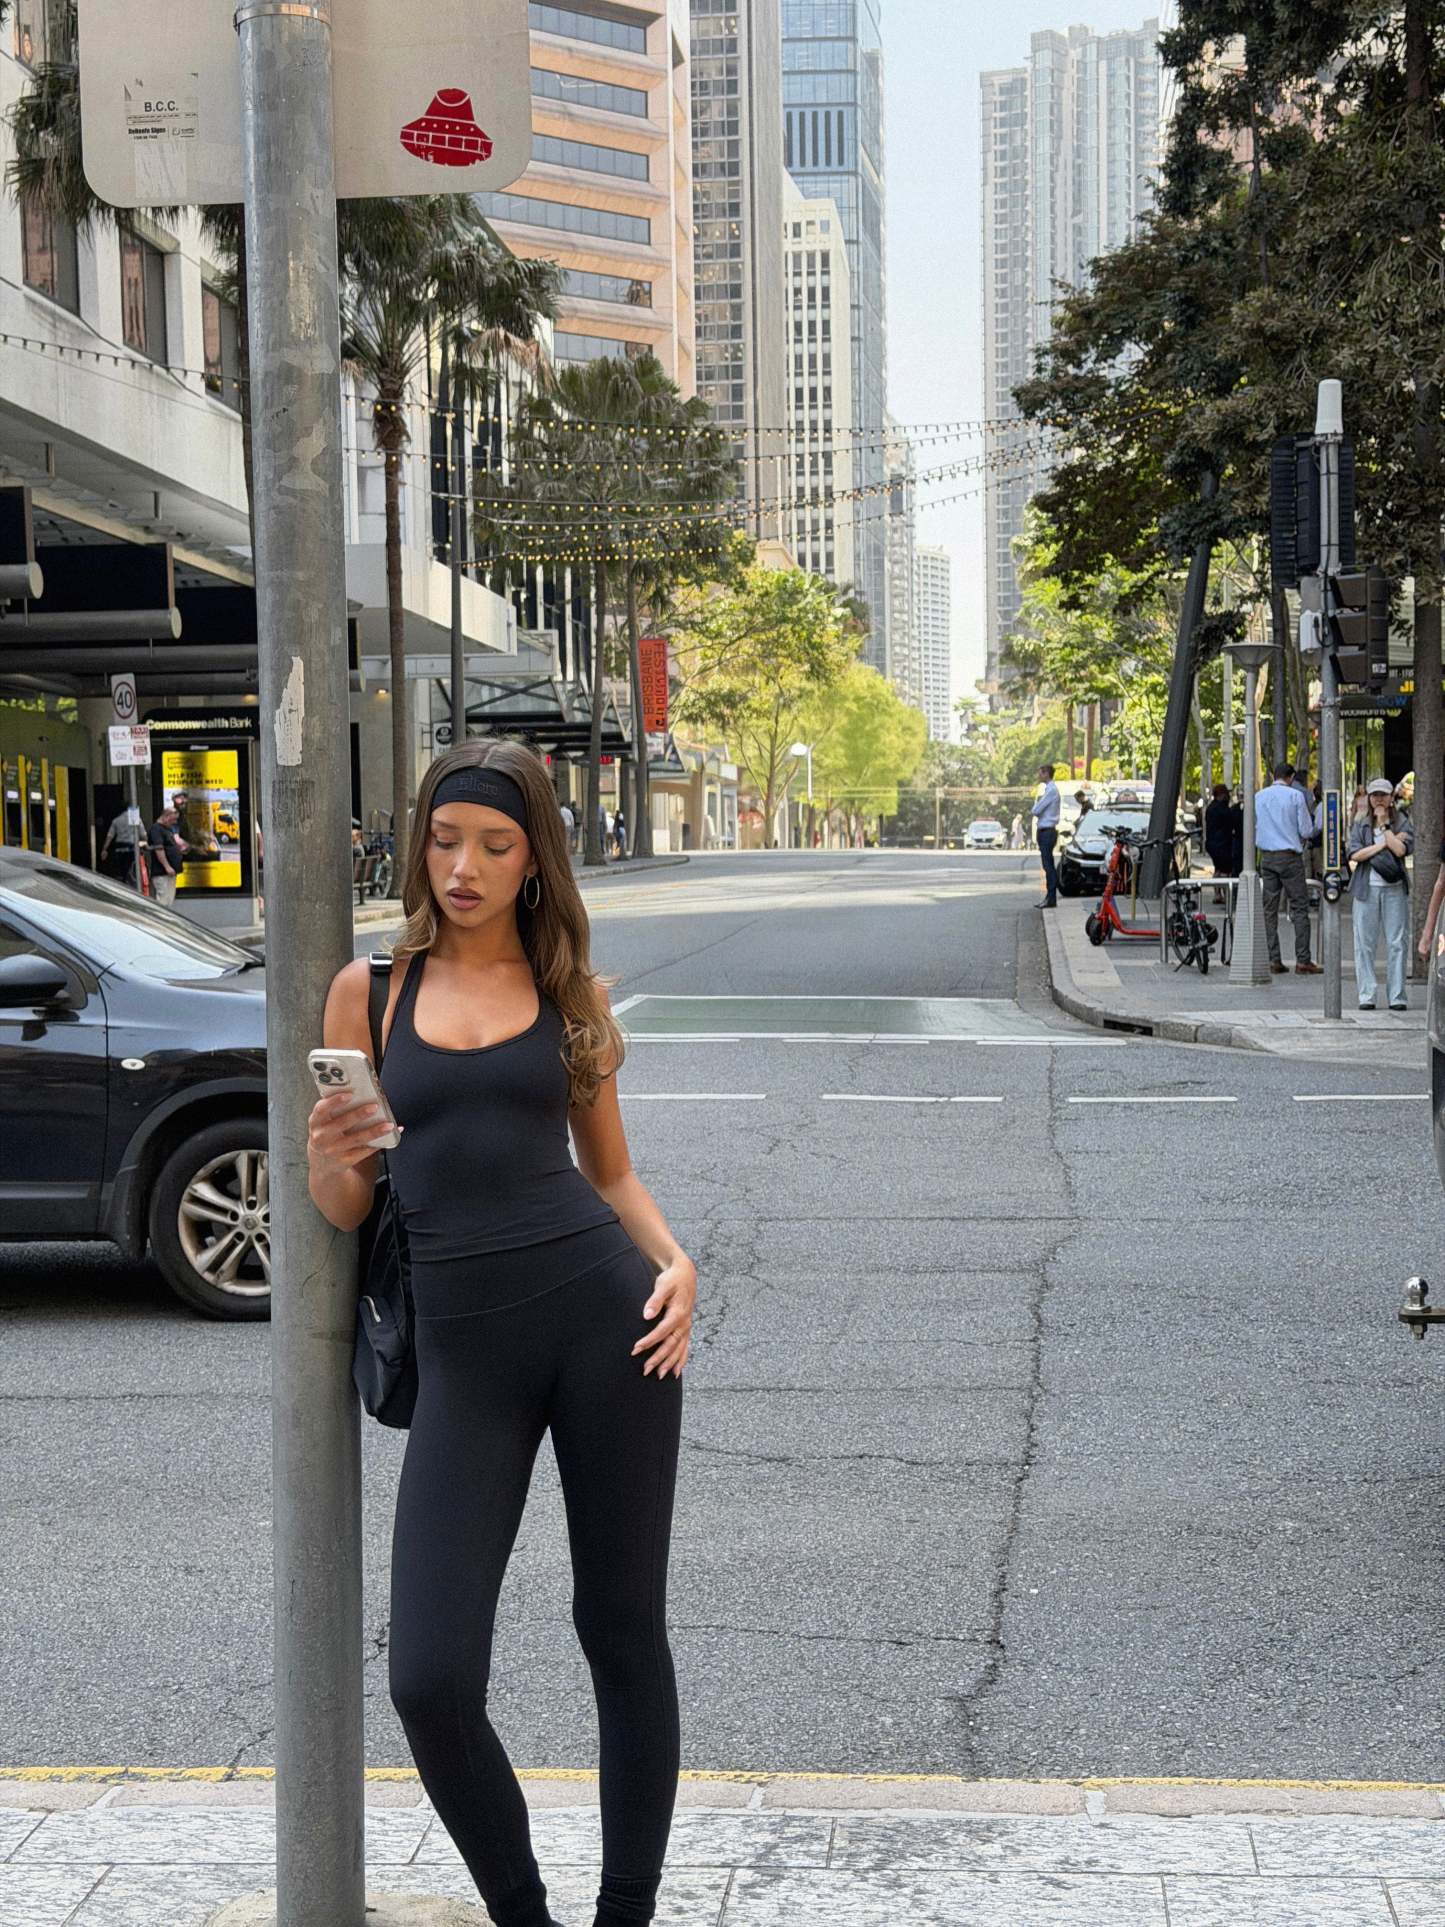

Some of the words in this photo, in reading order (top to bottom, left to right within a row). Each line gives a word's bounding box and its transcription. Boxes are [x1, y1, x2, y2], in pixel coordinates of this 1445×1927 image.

[144, 100, 179, 112] B.C.C.
[641, 648, 654, 715] BRISBANE
[116, 692, 134, 709] 40
[146, 719, 229, 730] Commonwealth
[230, 717, 252, 728] Bank
